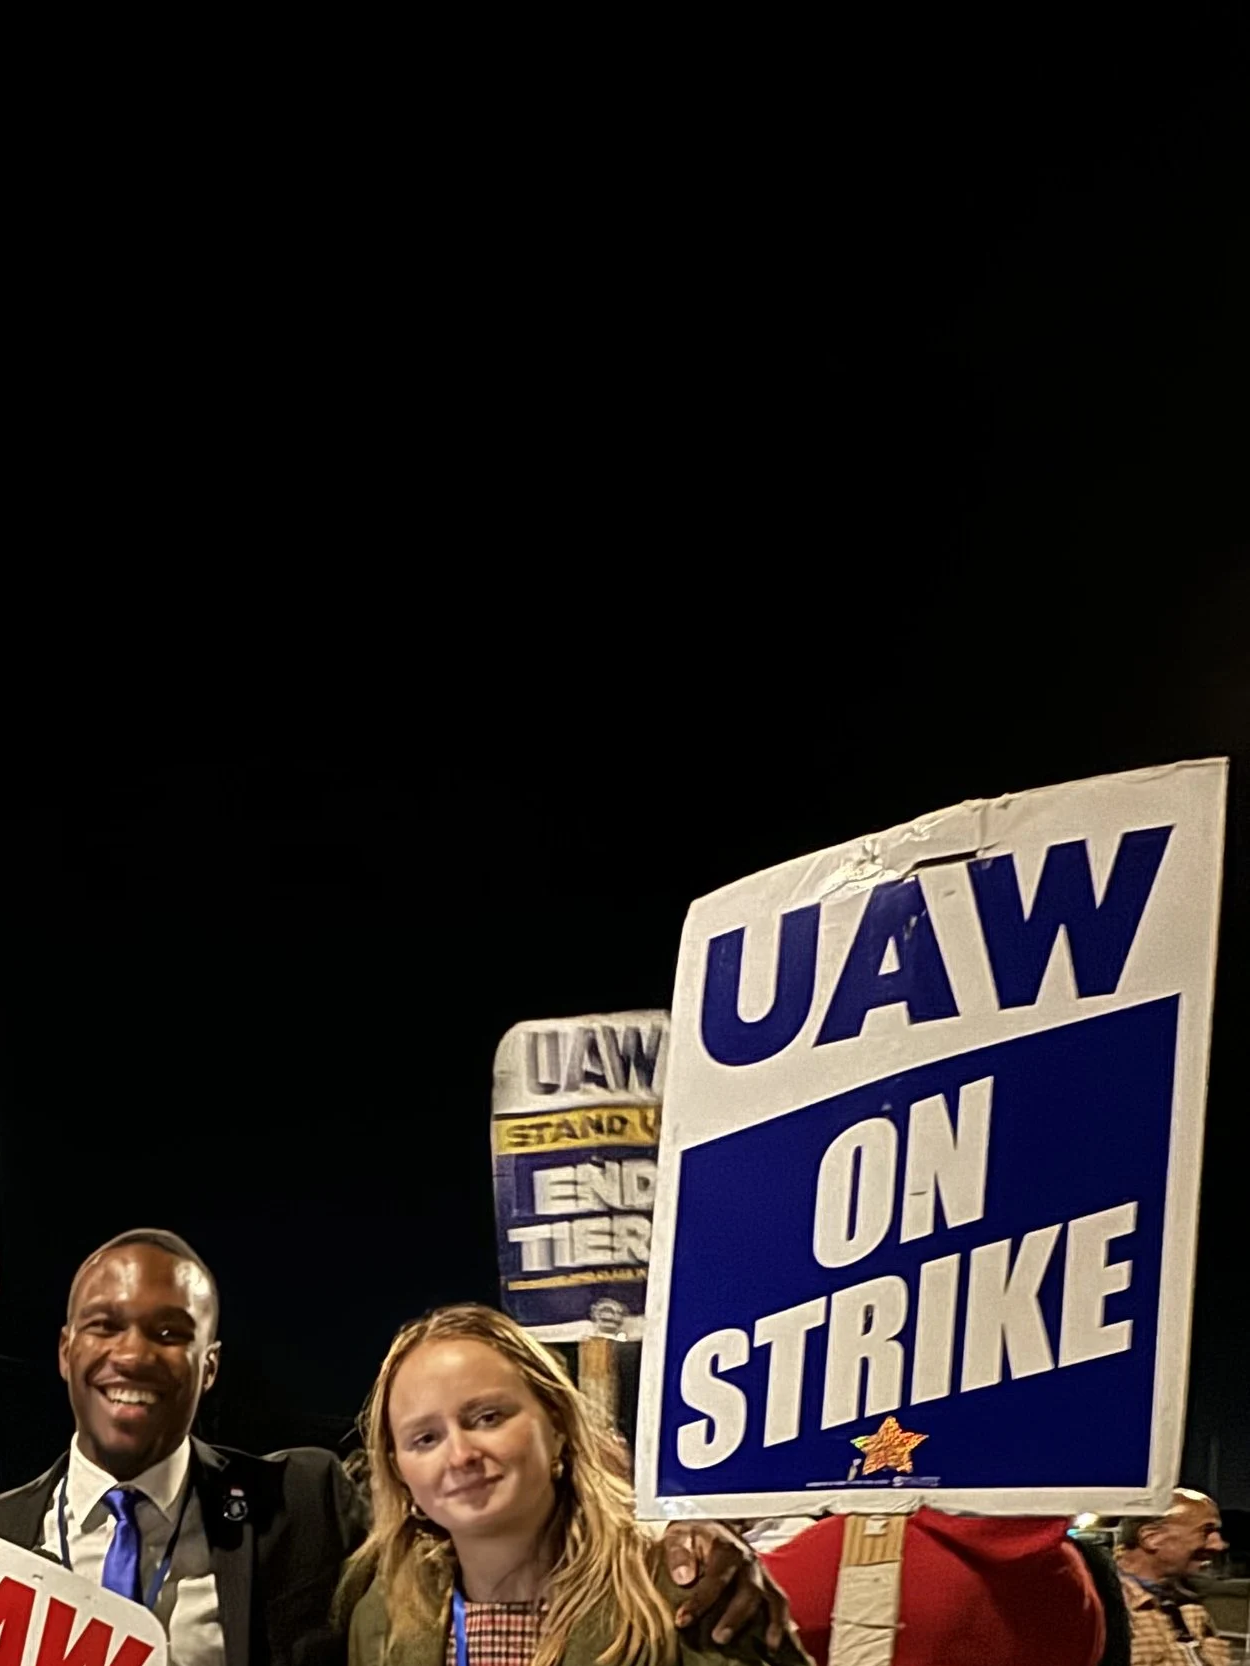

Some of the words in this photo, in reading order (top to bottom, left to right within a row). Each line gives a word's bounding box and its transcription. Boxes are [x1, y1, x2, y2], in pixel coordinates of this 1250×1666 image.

[701, 825, 1174, 1067] UAW
[525, 1026, 662, 1096] UAW
[506, 1113, 629, 1148] STAND
[639, 1107, 661, 1139] U
[533, 1159, 658, 1216] END
[813, 1076, 994, 1268] ON
[507, 1214, 652, 1272] TIER
[677, 1202, 1138, 1470] STRIKE
